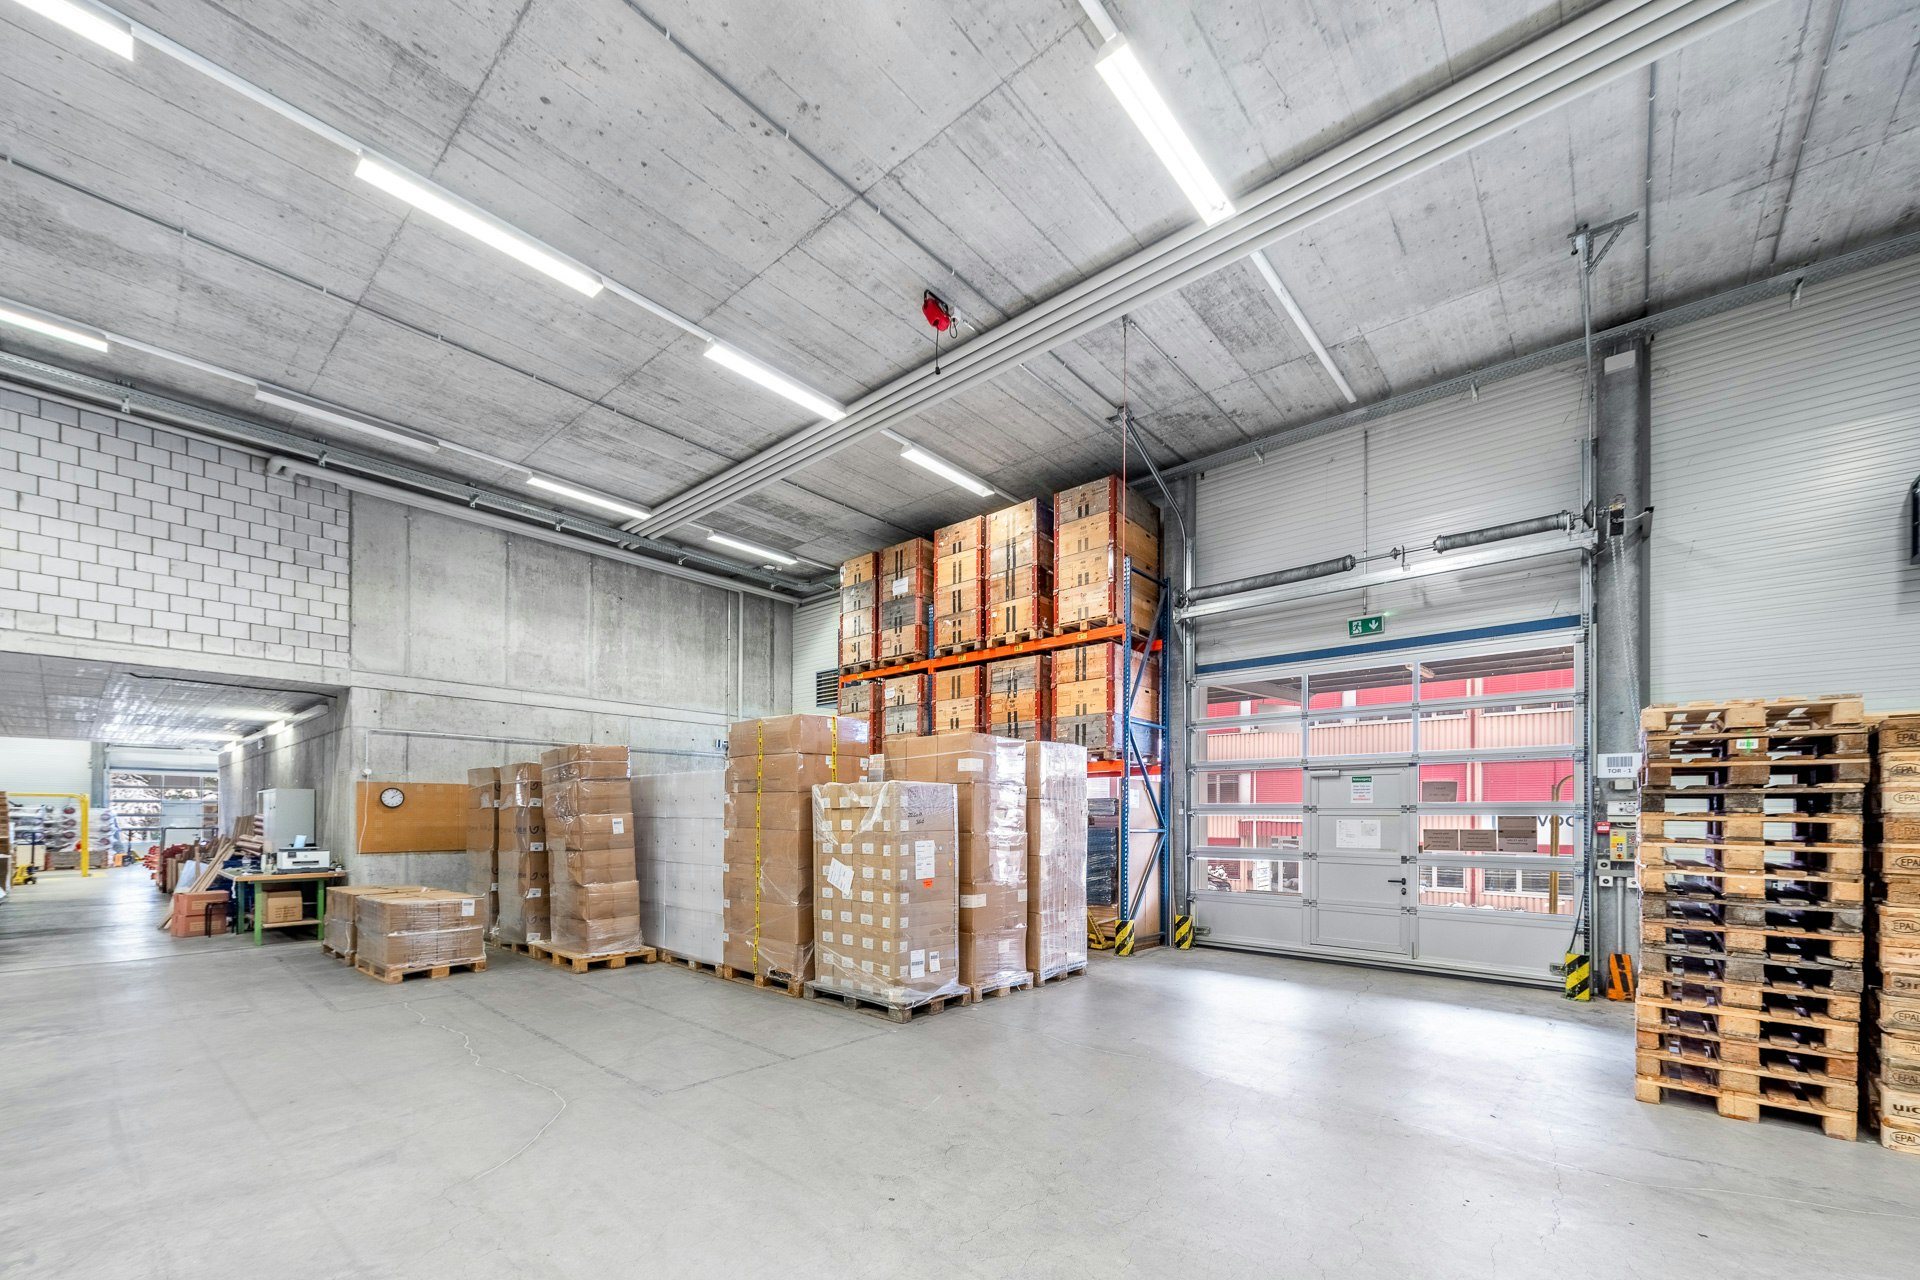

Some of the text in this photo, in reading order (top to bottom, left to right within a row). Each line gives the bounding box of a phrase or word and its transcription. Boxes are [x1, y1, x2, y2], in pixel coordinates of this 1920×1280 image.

[1893, 922, 1916, 931] EPAL
[1898, 1012, 1920, 1022] EPAL
[1894, 1133, 1917, 1143] EPAL
